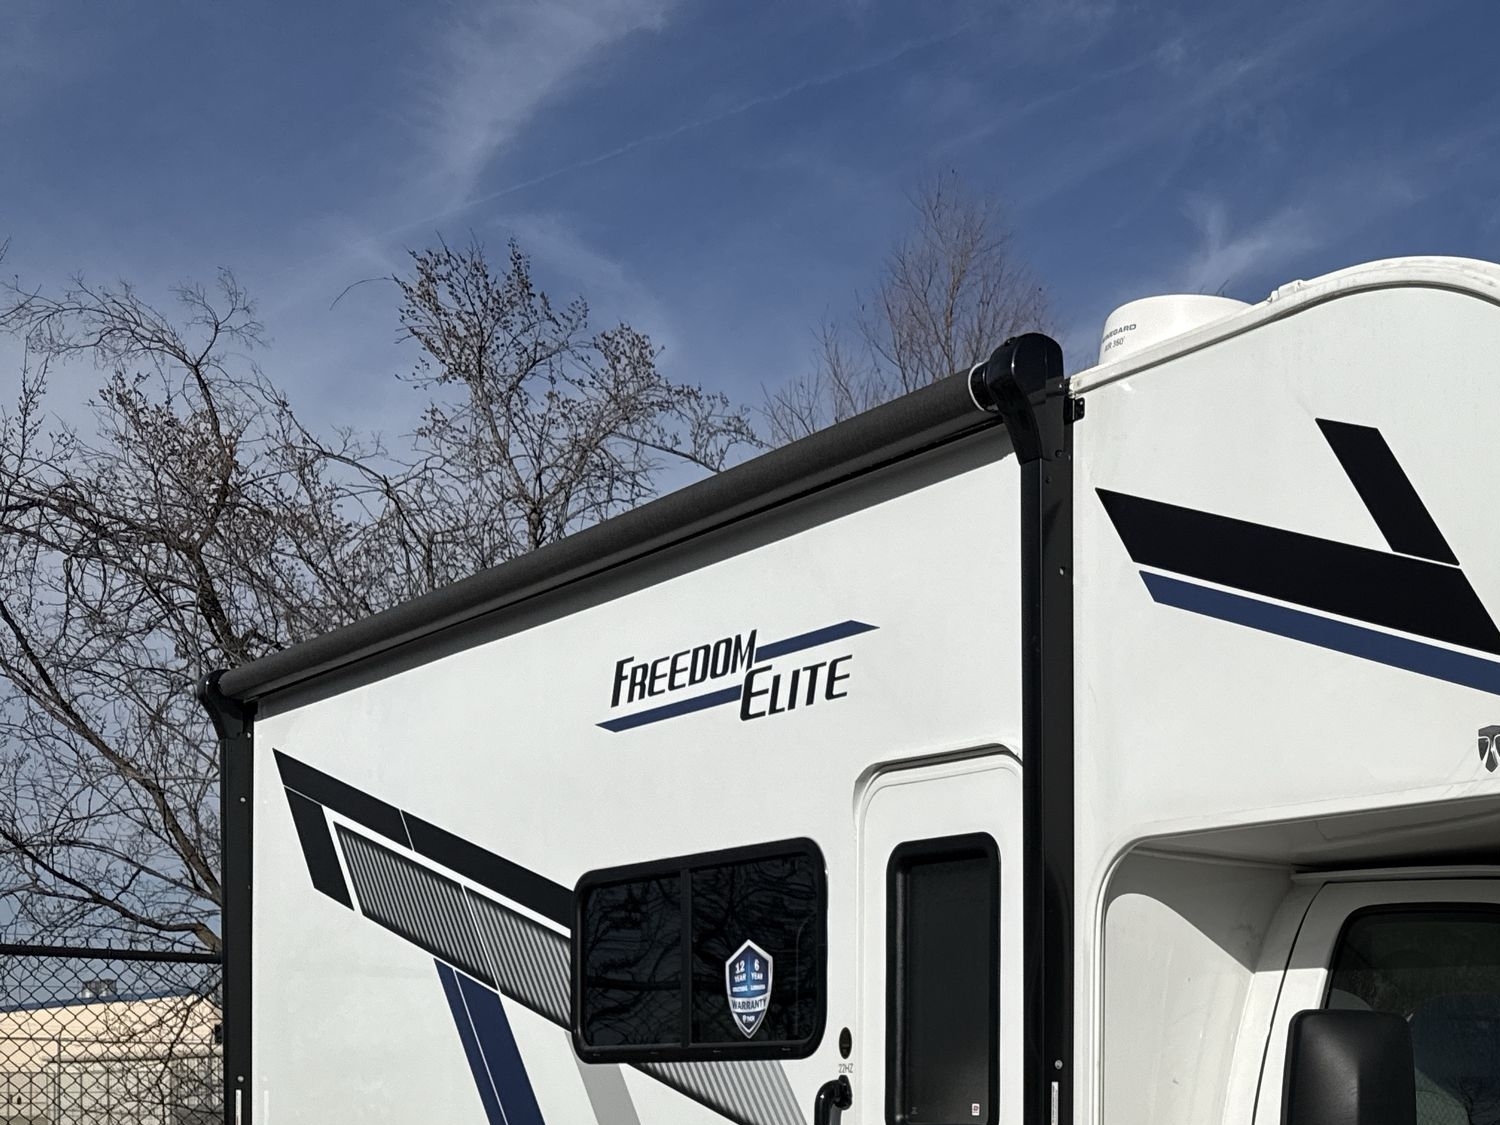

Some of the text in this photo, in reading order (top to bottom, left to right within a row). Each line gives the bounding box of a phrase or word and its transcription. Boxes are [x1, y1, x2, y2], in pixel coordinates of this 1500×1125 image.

[611, 628, 758, 708] FREEDOM
[740, 654, 852, 721] ELITE
[736, 961, 746, 973] 12
[754, 959, 760, 971] 6
[735, 973, 746, 982] YEAR
[751, 972, 763, 980] YEAR
[732, 997, 766, 1010] WARRANTY
